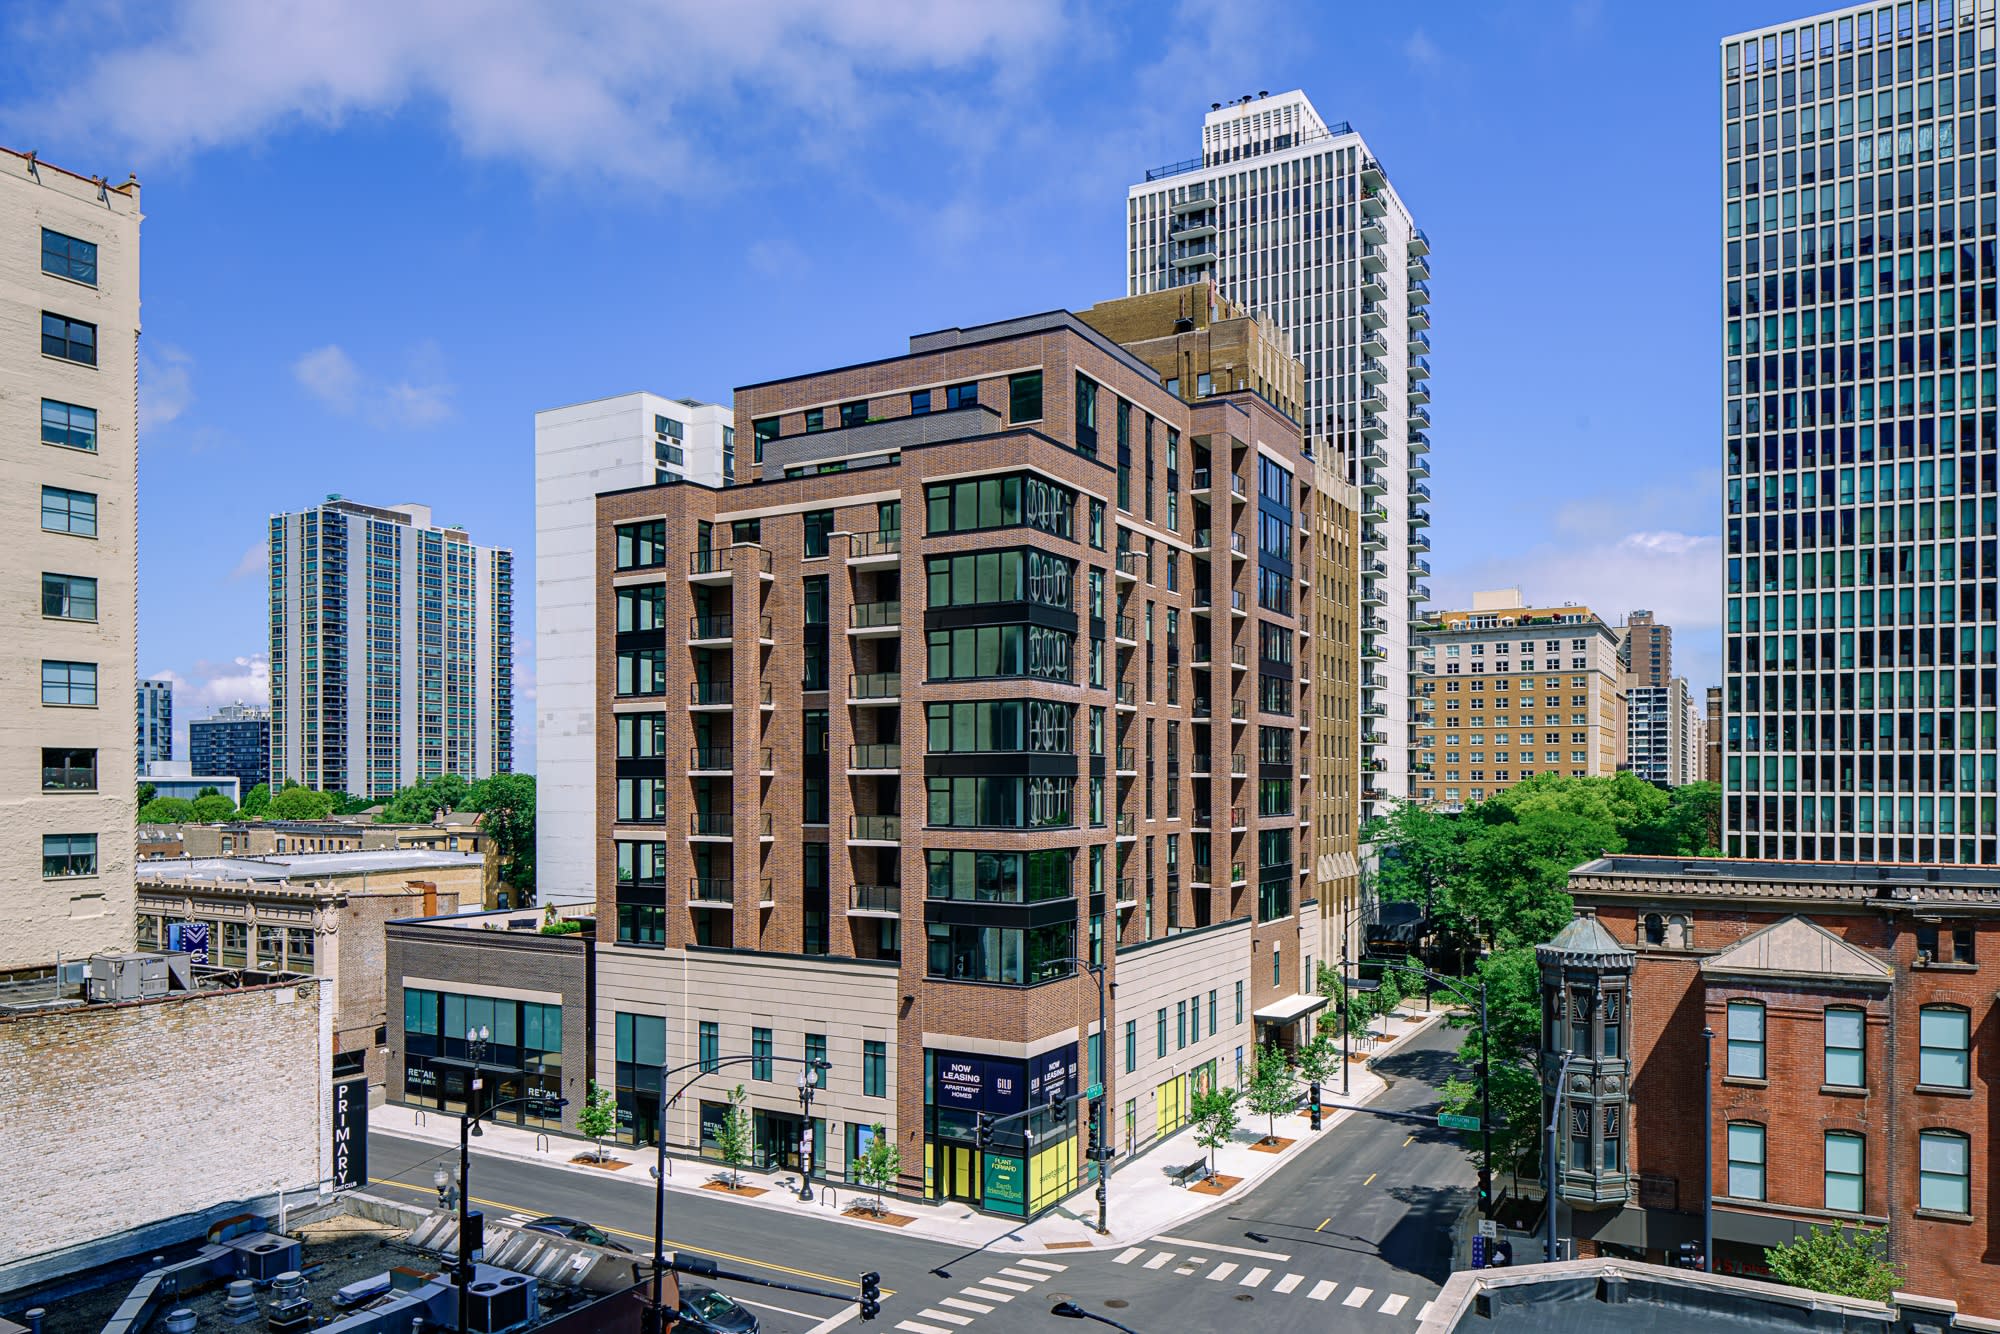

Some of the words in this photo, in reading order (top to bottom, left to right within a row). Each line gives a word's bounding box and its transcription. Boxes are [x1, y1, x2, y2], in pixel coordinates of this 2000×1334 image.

[951, 1063, 972, 1073] NOW
[1049, 1060, 1060, 1071] NOW
[942, 1071, 980, 1083] LEASING
[1044, 1067, 1065, 1081] LEASING
[944, 1084, 980, 1094] APARTMENT
[951, 1091, 972, 1099] HOMES
[336, 1085, 350, 1183] PRIMARY
[994, 1157, 1012, 1166] PLANT
[991, 1162, 1017, 1173] FORWARD
